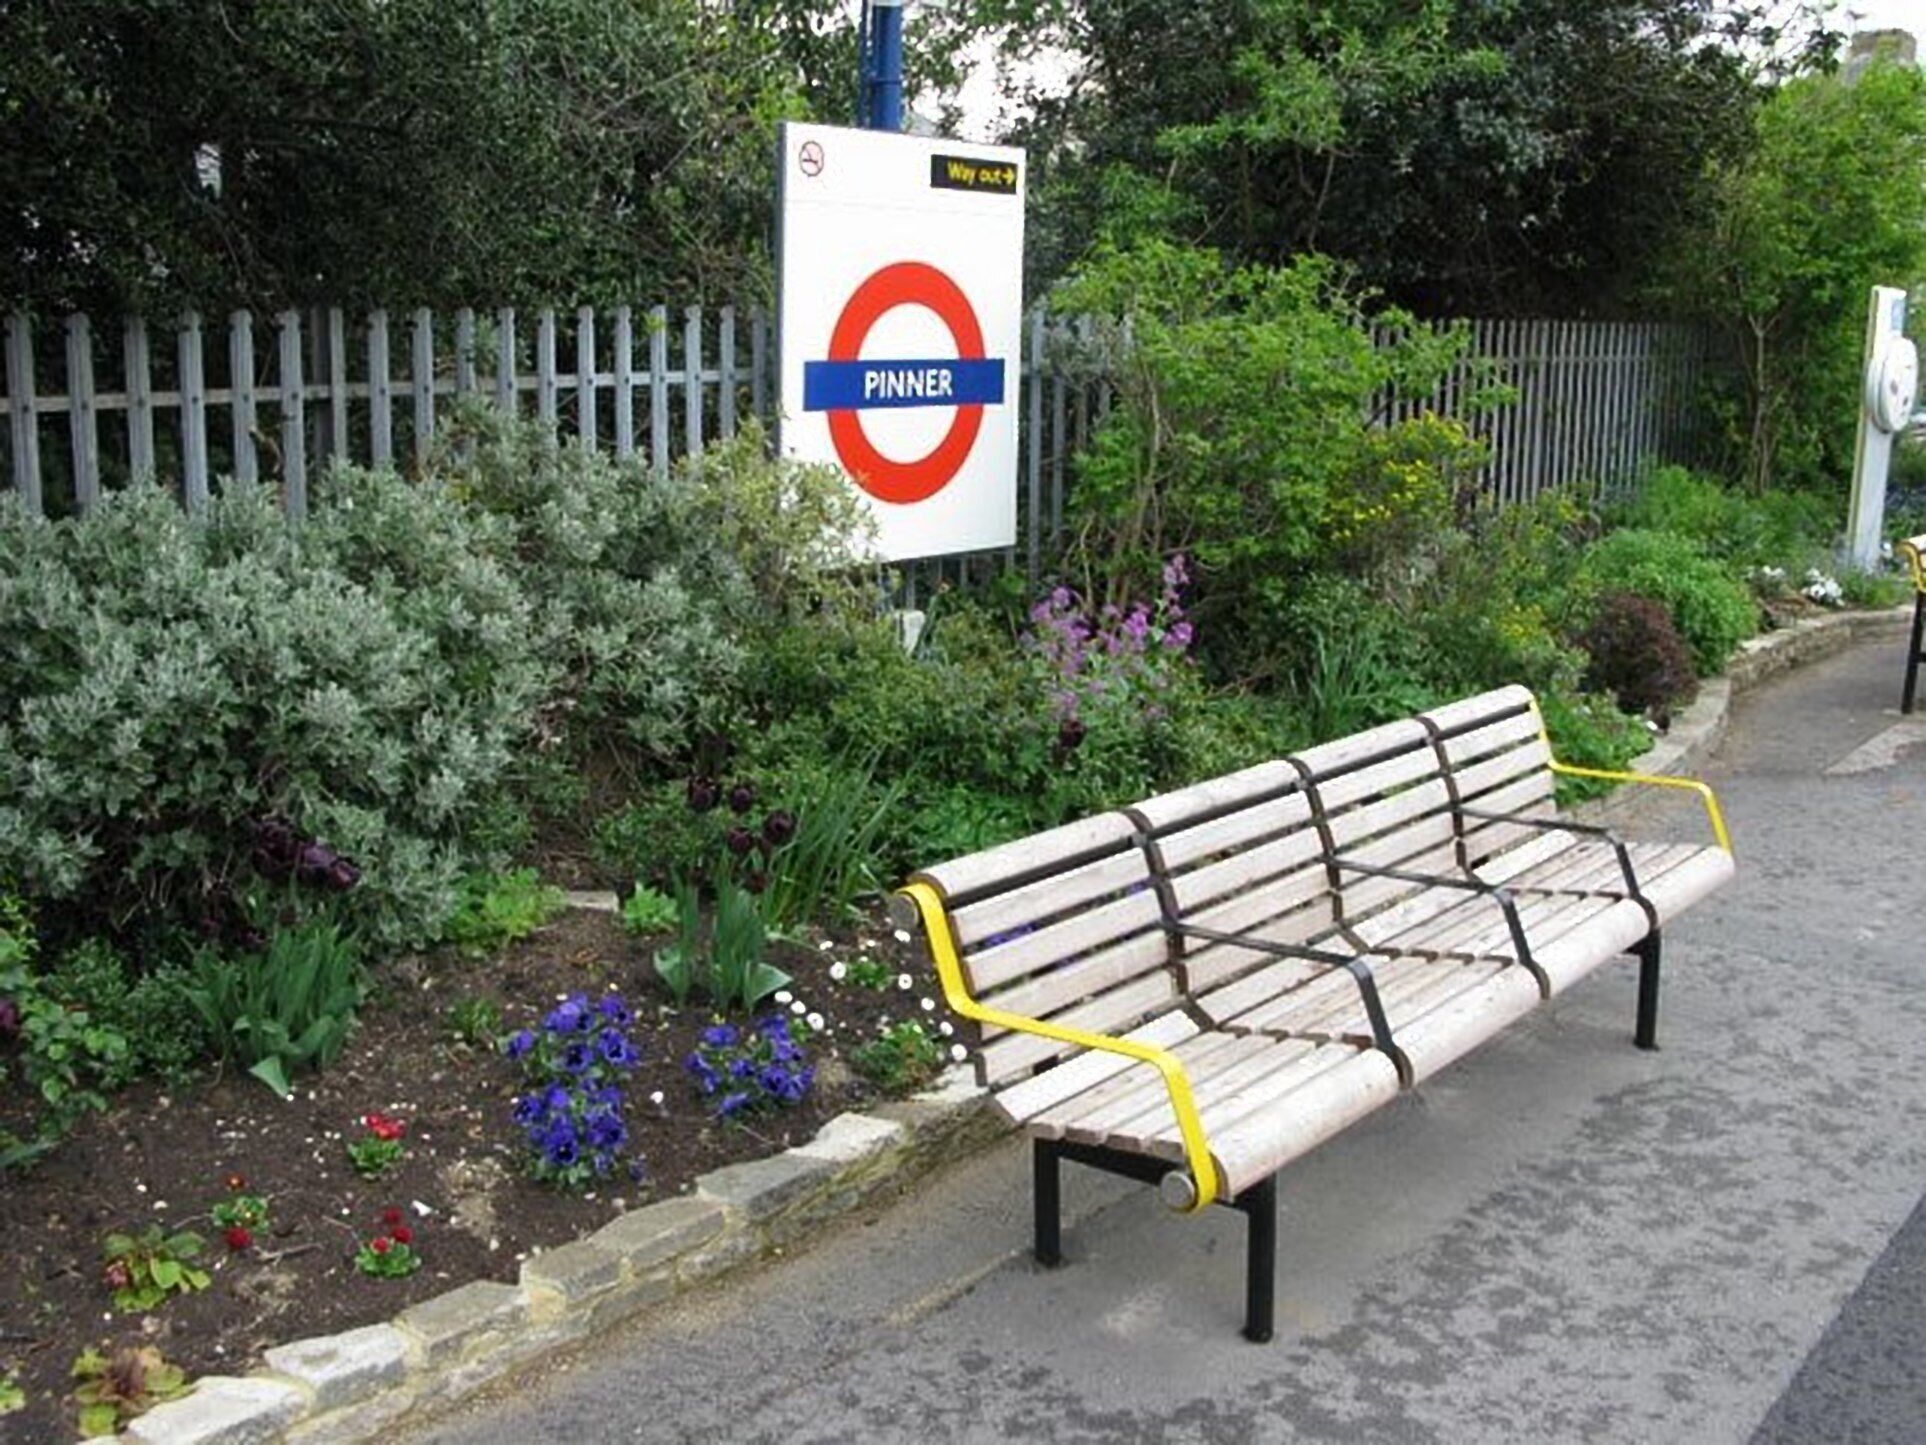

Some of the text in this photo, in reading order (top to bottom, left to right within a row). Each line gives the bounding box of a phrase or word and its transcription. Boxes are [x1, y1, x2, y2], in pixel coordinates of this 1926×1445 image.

[947, 161, 1002, 186] Way out
[864, 368, 953, 400] PINNER
